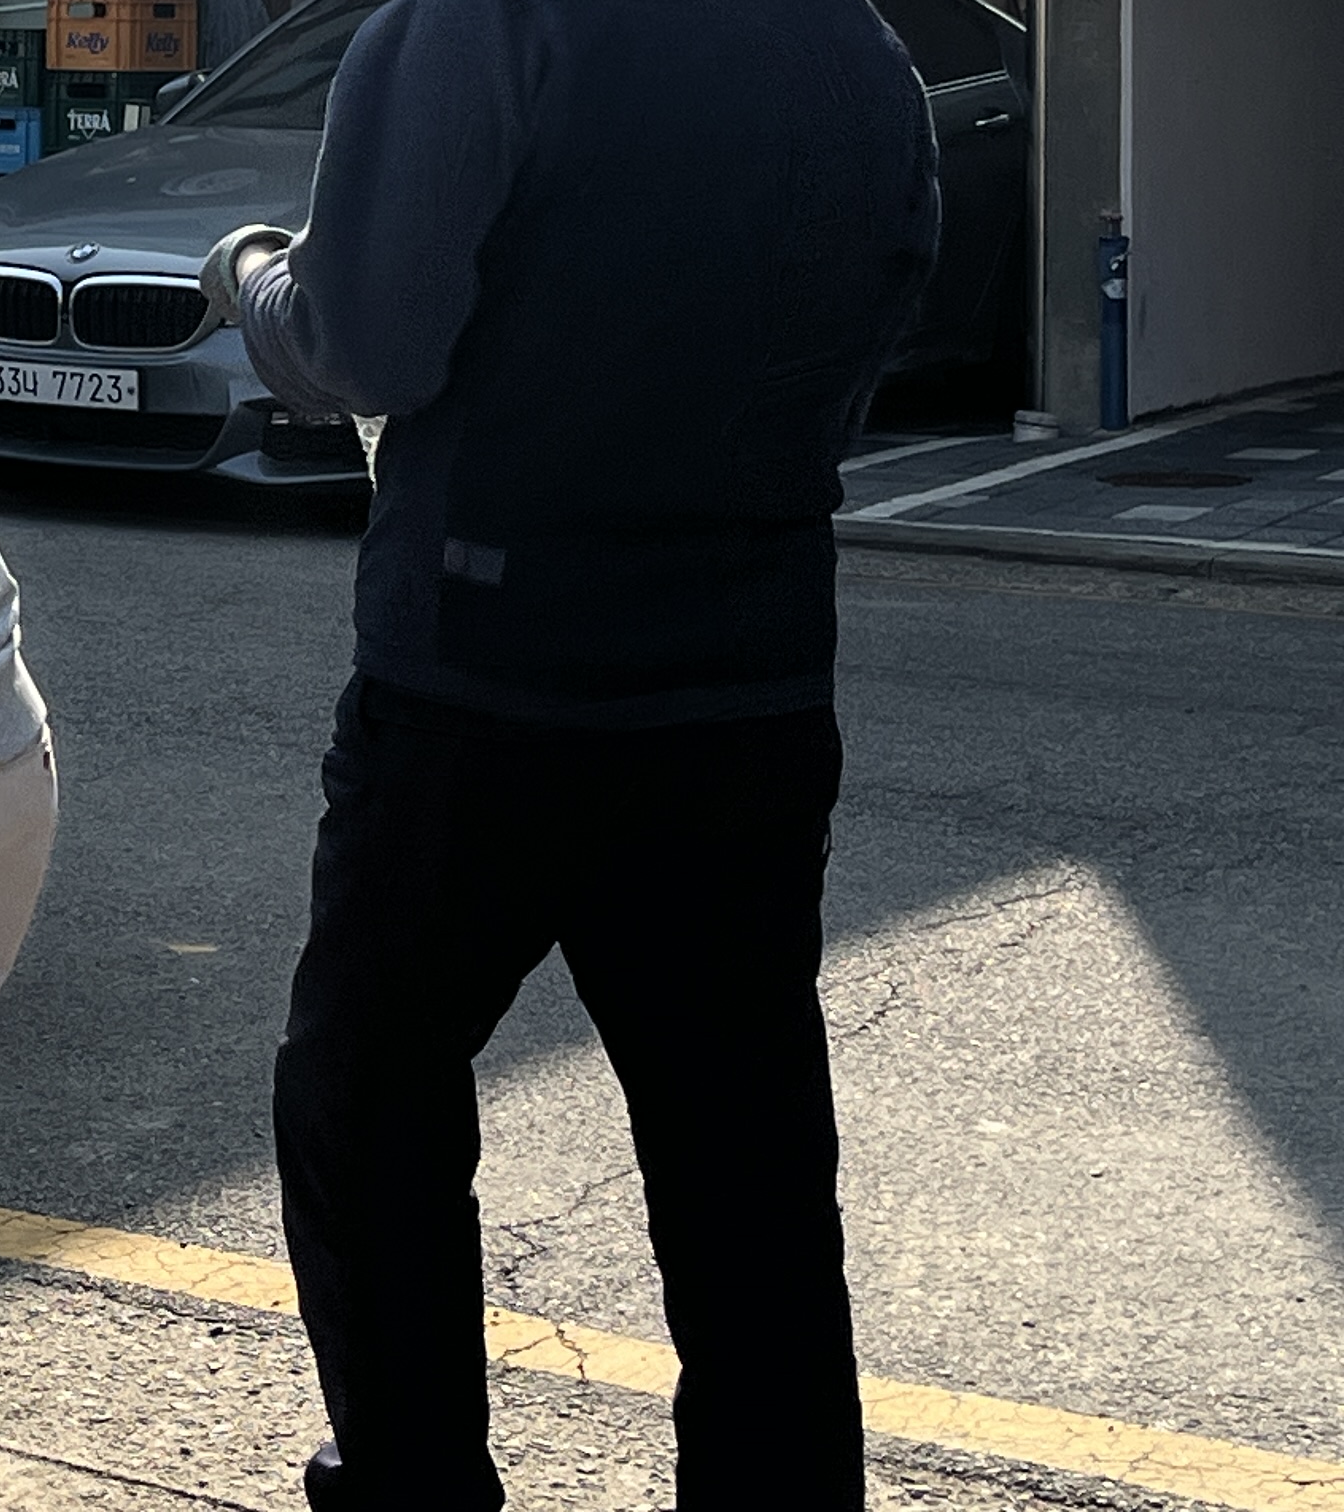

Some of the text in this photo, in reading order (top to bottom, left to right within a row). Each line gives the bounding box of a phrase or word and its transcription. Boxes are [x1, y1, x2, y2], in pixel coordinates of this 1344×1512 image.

[66, 32, 110, 55] Kelly
[67, 109, 111, 133] TERRA
[52, 370, 123, 404] 7723
